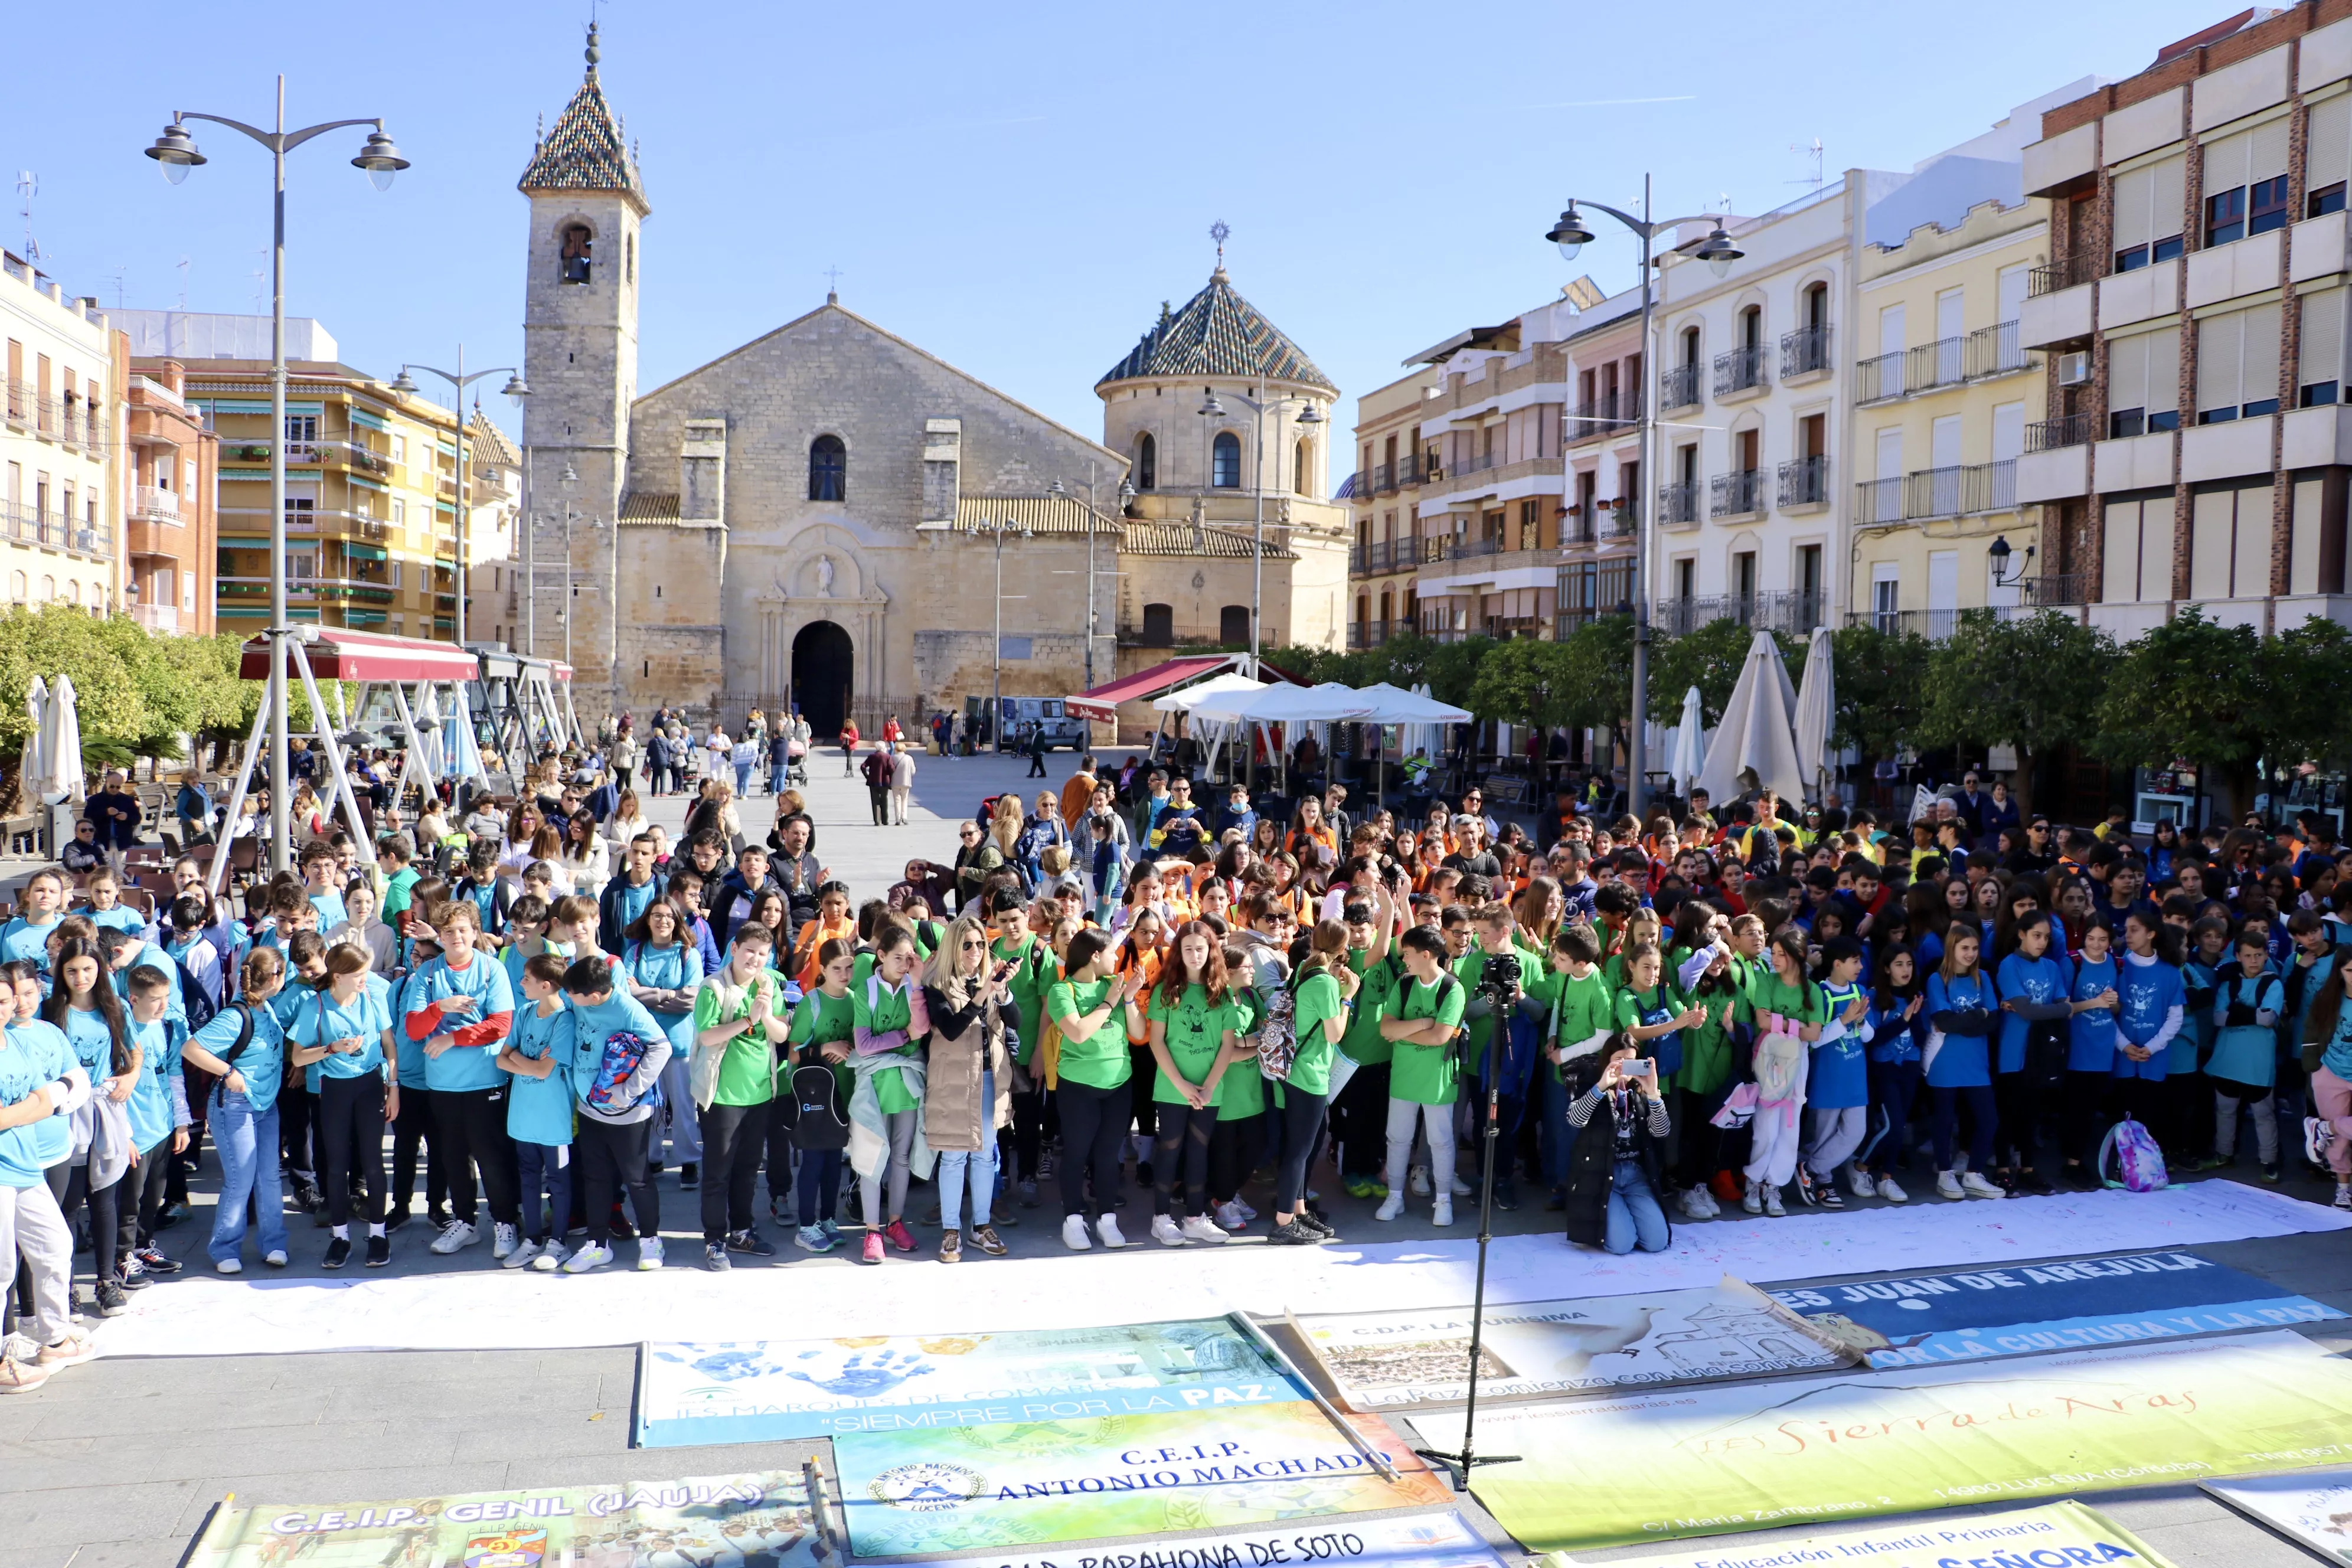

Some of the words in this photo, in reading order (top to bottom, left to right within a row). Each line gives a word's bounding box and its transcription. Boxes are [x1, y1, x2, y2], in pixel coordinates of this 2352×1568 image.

[1768, 1290, 1832, 1308] ES
[1840, 1277, 1961, 1302] JUAN
[1952, 1272, 2027, 1291] DE
[1353, 1325, 1425, 1335] C.D.P.
[1429, 1321, 1464, 1330] LA
[1864, 1346, 1939, 1365] OR
[1935, 1340, 1998, 1358] LA
[1996, 1320, 2178, 1352] CULTURA
[2167, 1316, 2199, 1332] Y
[2203, 1312, 2259, 1327] LA
[2250, 1304, 2343, 1324] PAZ
[1363, 1391, 1407, 1406] La
[1408, 1387, 1468, 1403] Paz
[1474, 1375, 1617, 1397] comienza
[1618, 1371, 1672, 1384] con
[1672, 1366, 1730, 1379] una
[1729, 1354, 1835, 1374] sonrisa
[909, 1394, 950, 1405] DE
[1023, 1399, 1112, 1418] POR
[1122, 1396, 1175, 1410] LA
[1701, 1433, 1766, 1455] IES
[1773, 1410, 1990, 1455] Sierra
[1997, 1402, 2049, 1420] de
[2054, 1391, 2197, 1420] Aras
[1121, 1441, 1251, 1465] C.E.I.P.
[876, 1464, 917, 1481] ANTONIO
[925, 1462, 975, 1476] MACHADO
[996, 1471, 1181, 1501] ANTONIO
[1188, 1451, 1393, 1484] MACHADO
[1932, 1482, 2002, 1499] 14900
[2002, 1471, 2105, 1489] LUCENA
[2105, 1459, 2213, 1479] (Córdoba)
[271, 1507, 429, 1534] C.E.I.P.
[444, 1496, 575, 1523] GENIL
[587, 1482, 765, 1518] (JAUJA)
[911, 1503, 959, 1512] LUCENA
[1748, 1498, 1876, 1521] Zambrano,
[1877, 1495, 1897, 1505] 2
[514, 1521, 545, 1531] GENIL
[884, 1514, 959, 1536] ANTONIO
[971, 1514, 1047, 1543] MACHADO
[1835, 1534, 1936, 1557] Infantil
[1938, 1520, 2056, 1545] Primaria
[1246, 1539, 1291, 1566] DE
[1293, 1533, 1364, 1563] SOTO
